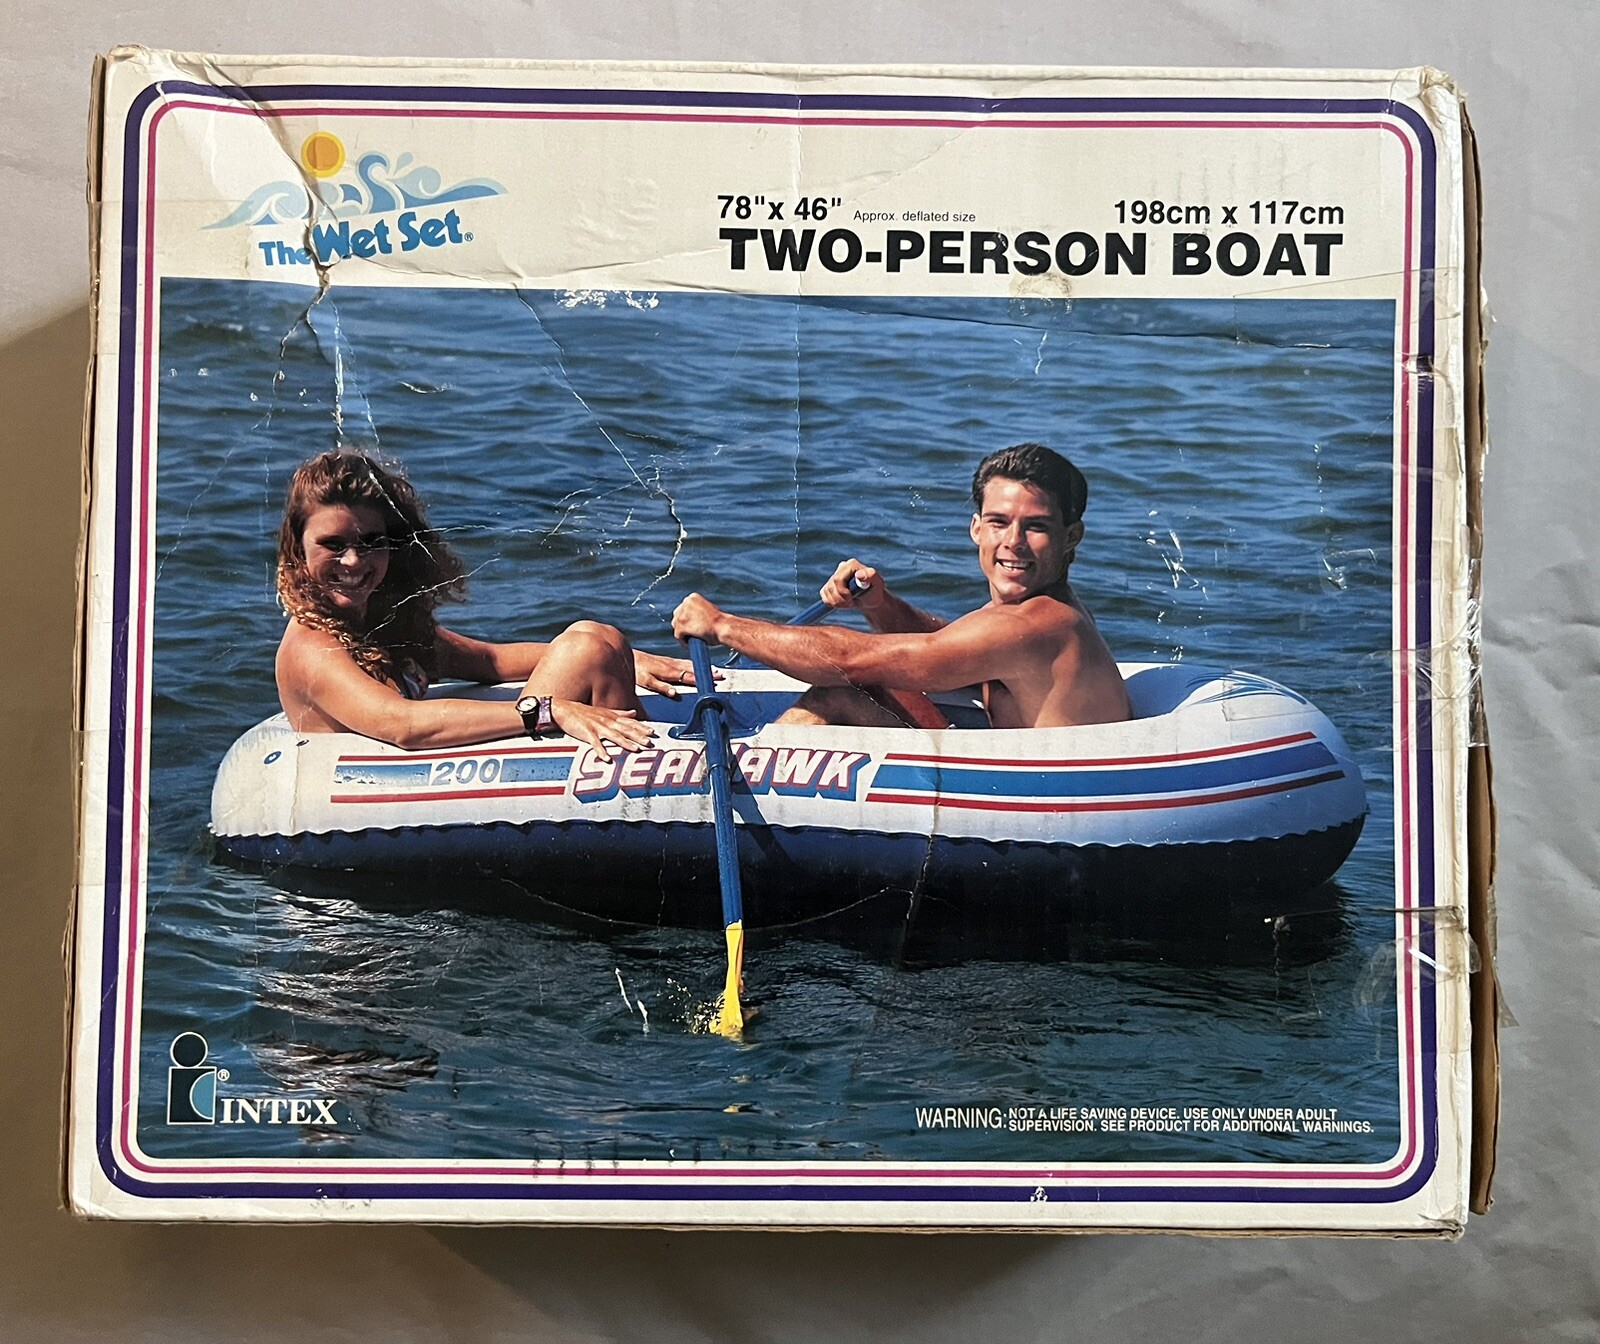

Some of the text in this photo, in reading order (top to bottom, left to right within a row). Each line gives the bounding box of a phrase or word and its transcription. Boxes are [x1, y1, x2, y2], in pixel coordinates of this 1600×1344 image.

[853, 209, 899, 223] Approx.
[902, 210, 949, 222] deflated
[952, 211, 977, 223] size
[1114, 200, 1344, 225] 198cm x 117cm
[258, 240, 312, 266] The
[312, 219, 393, 263] Wet
[719, 227, 1344, 277] TWO-PERSON BOAT
[431, 757, 501, 786] 200
[219, 1098, 338, 1125] INTEX
[915, 1107, 1007, 1129] WARNING:
[1008, 1107, 1338, 1121] NOT A LIFE SAVING DEVICE. USE ONLY UNDER ADULT
[1008, 1119, 1375, 1134] SUPERVISION. SEE PRODUCT FOR ADDITIONAL WARNINGS.
